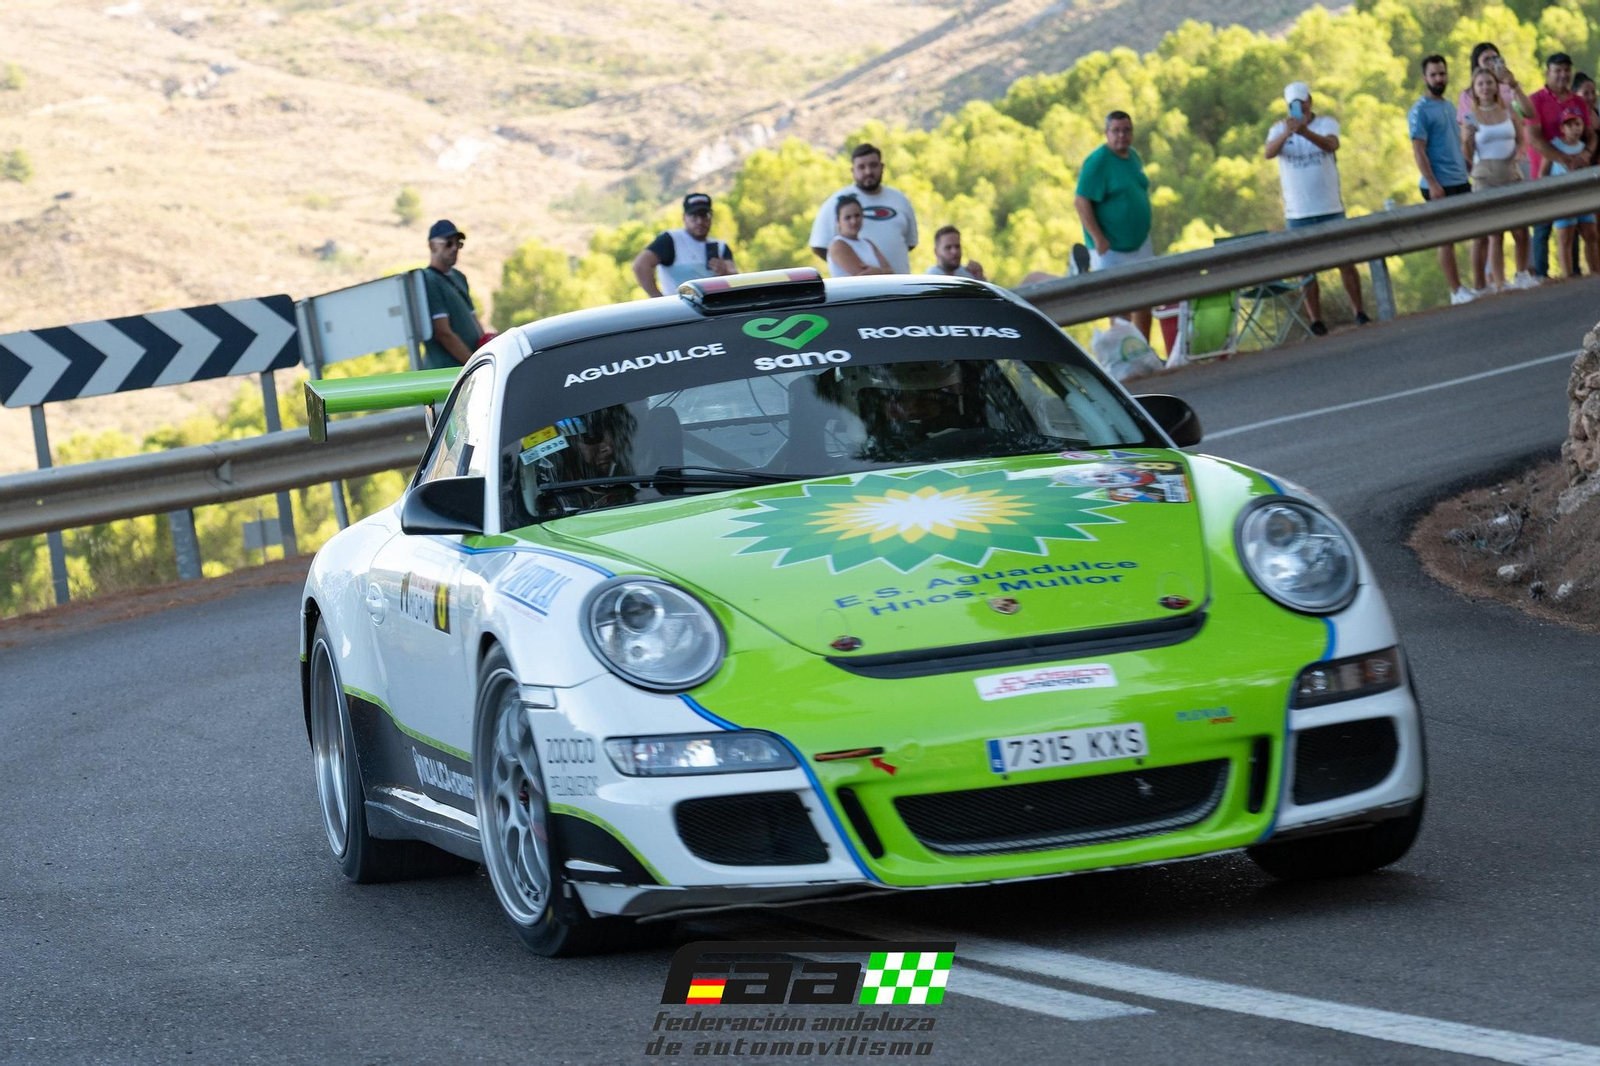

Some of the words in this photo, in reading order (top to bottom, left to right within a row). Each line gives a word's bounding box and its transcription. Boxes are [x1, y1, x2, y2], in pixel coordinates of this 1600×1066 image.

[857, 325, 1021, 340] ROQUETAS
[563, 343, 727, 388] AGUADULCE
[753, 349, 852, 371] sano
[835, 587, 915, 609] E.S.
[927, 558, 1138, 590] Aguadulce
[869, 590, 987, 616] Hnos.
[1000, 572, 1125, 593] Mullor
[1006, 734, 1076, 767] 7315
[1086, 728, 1145, 759] KXS
